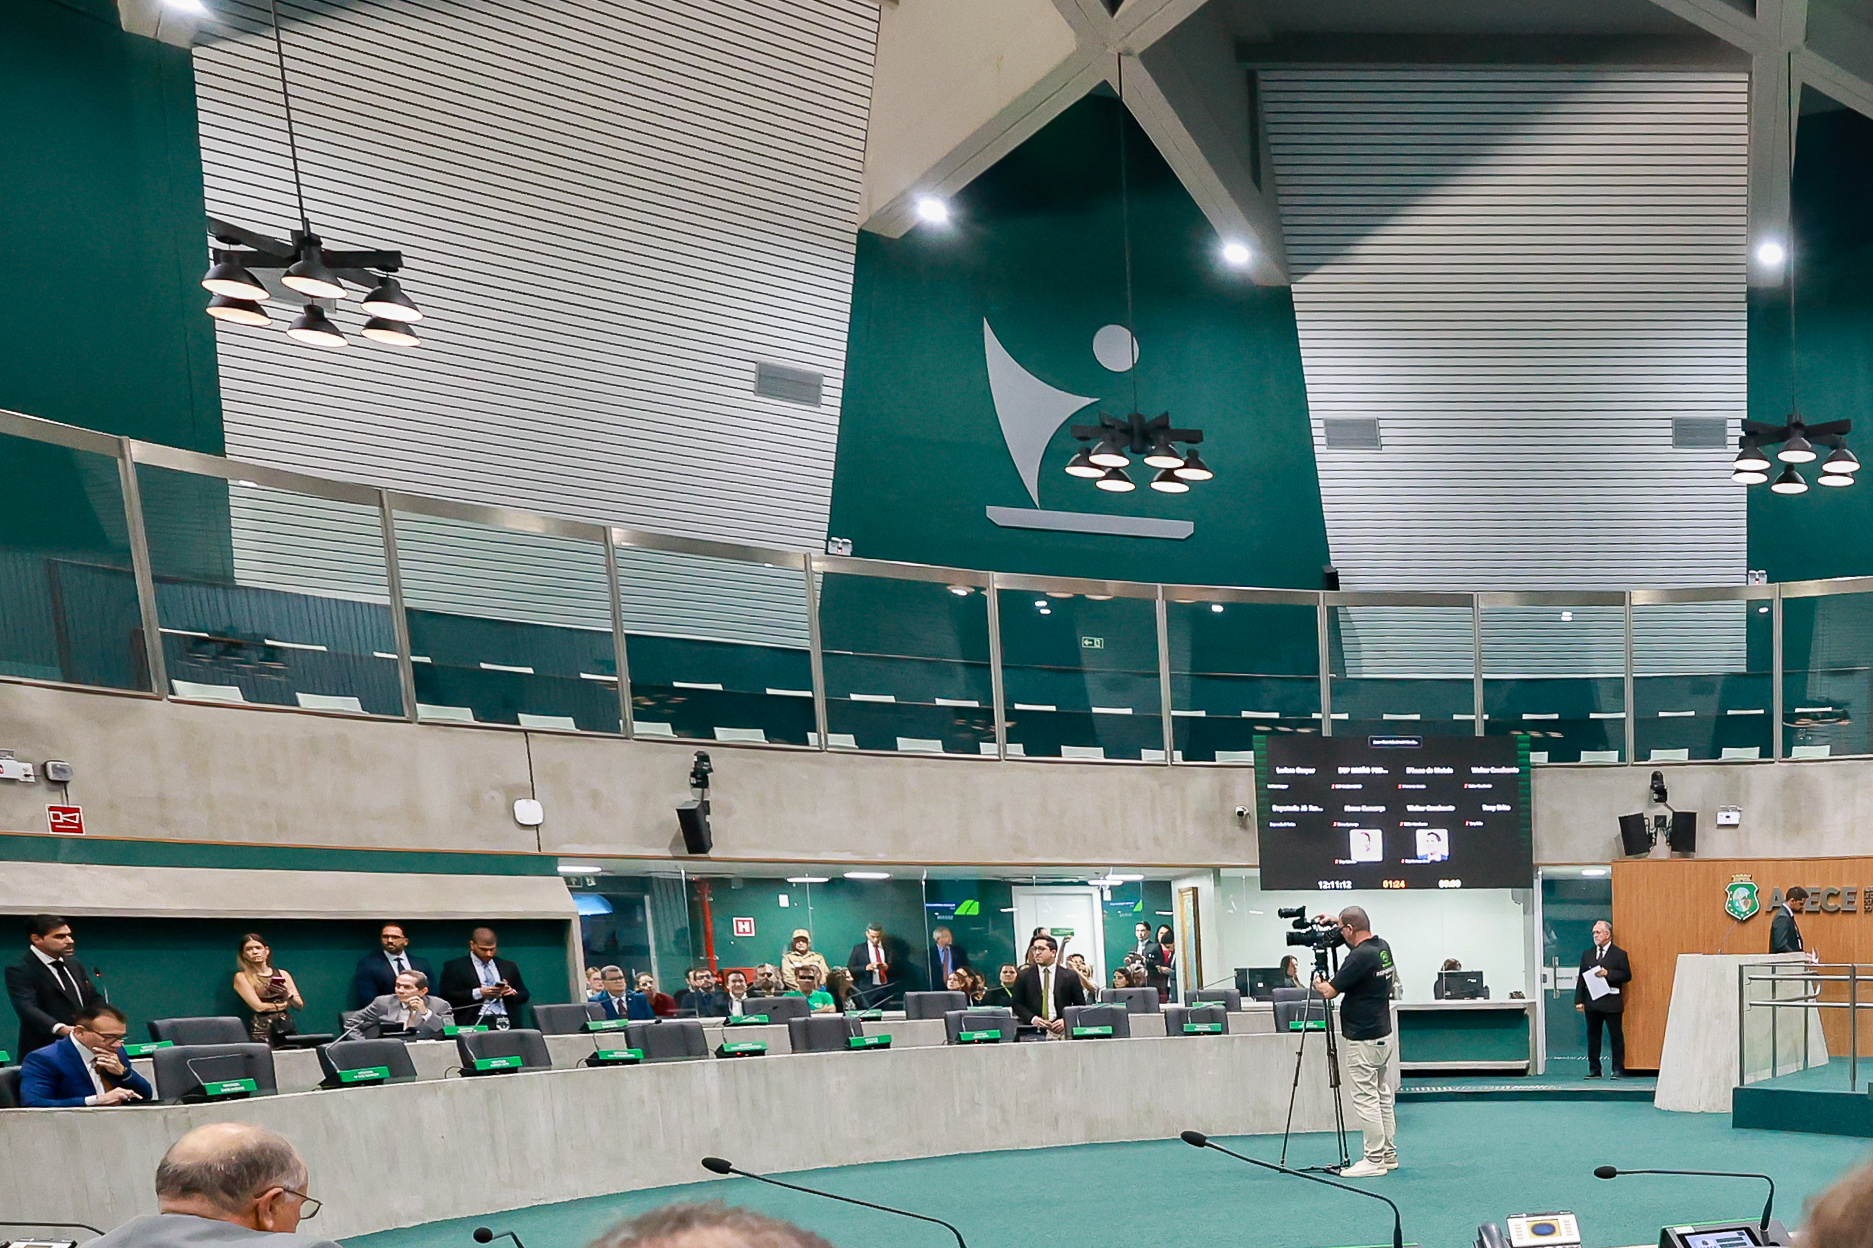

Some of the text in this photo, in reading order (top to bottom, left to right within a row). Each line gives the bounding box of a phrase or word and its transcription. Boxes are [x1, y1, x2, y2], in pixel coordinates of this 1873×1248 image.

[1382, 880, 1405, 888] 01:24
[1765, 887, 1857, 913] AECE
[737, 921, 751, 933] H
